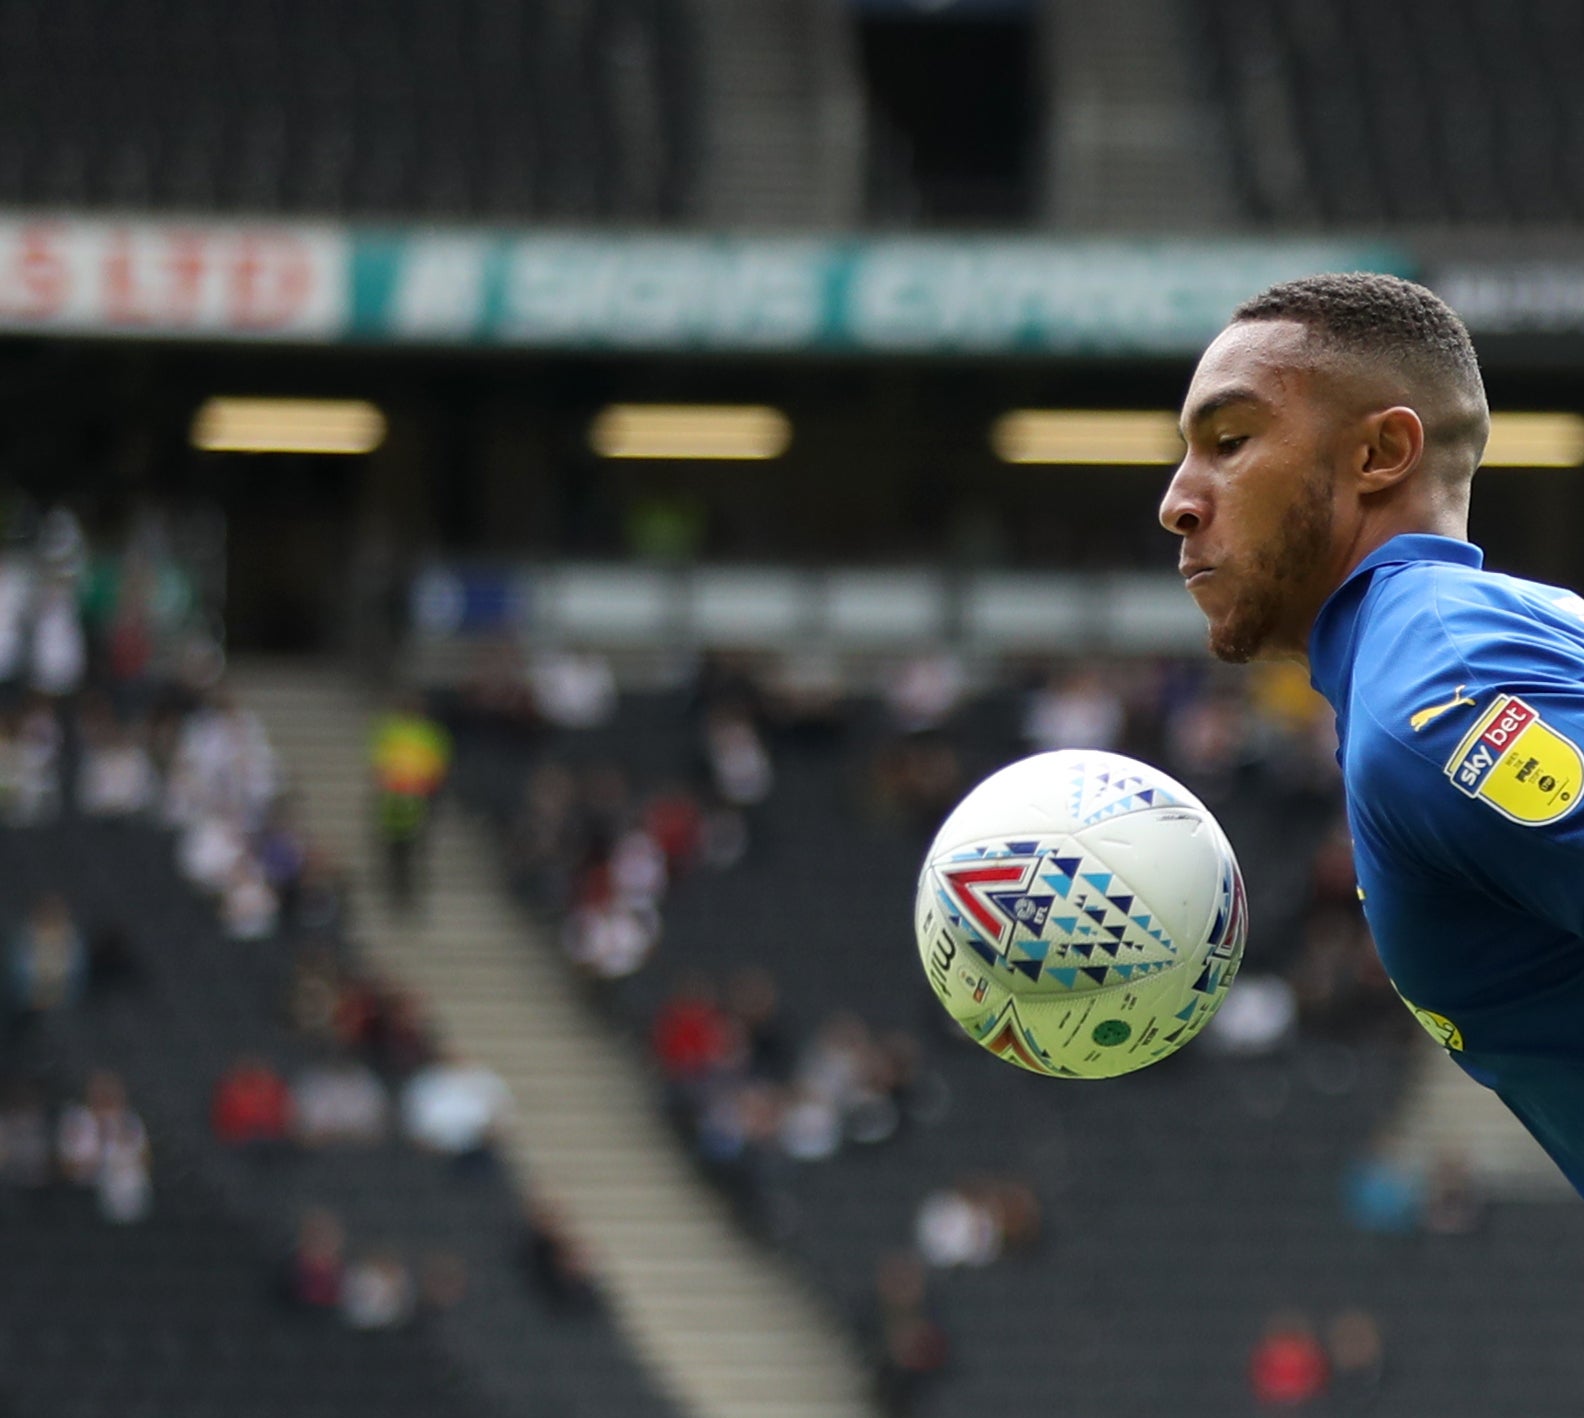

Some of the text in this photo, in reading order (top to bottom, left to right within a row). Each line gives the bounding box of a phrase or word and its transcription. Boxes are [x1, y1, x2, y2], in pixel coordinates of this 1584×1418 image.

[1461, 707, 1527, 786] sky bet
[930, 928, 957, 999] mit
